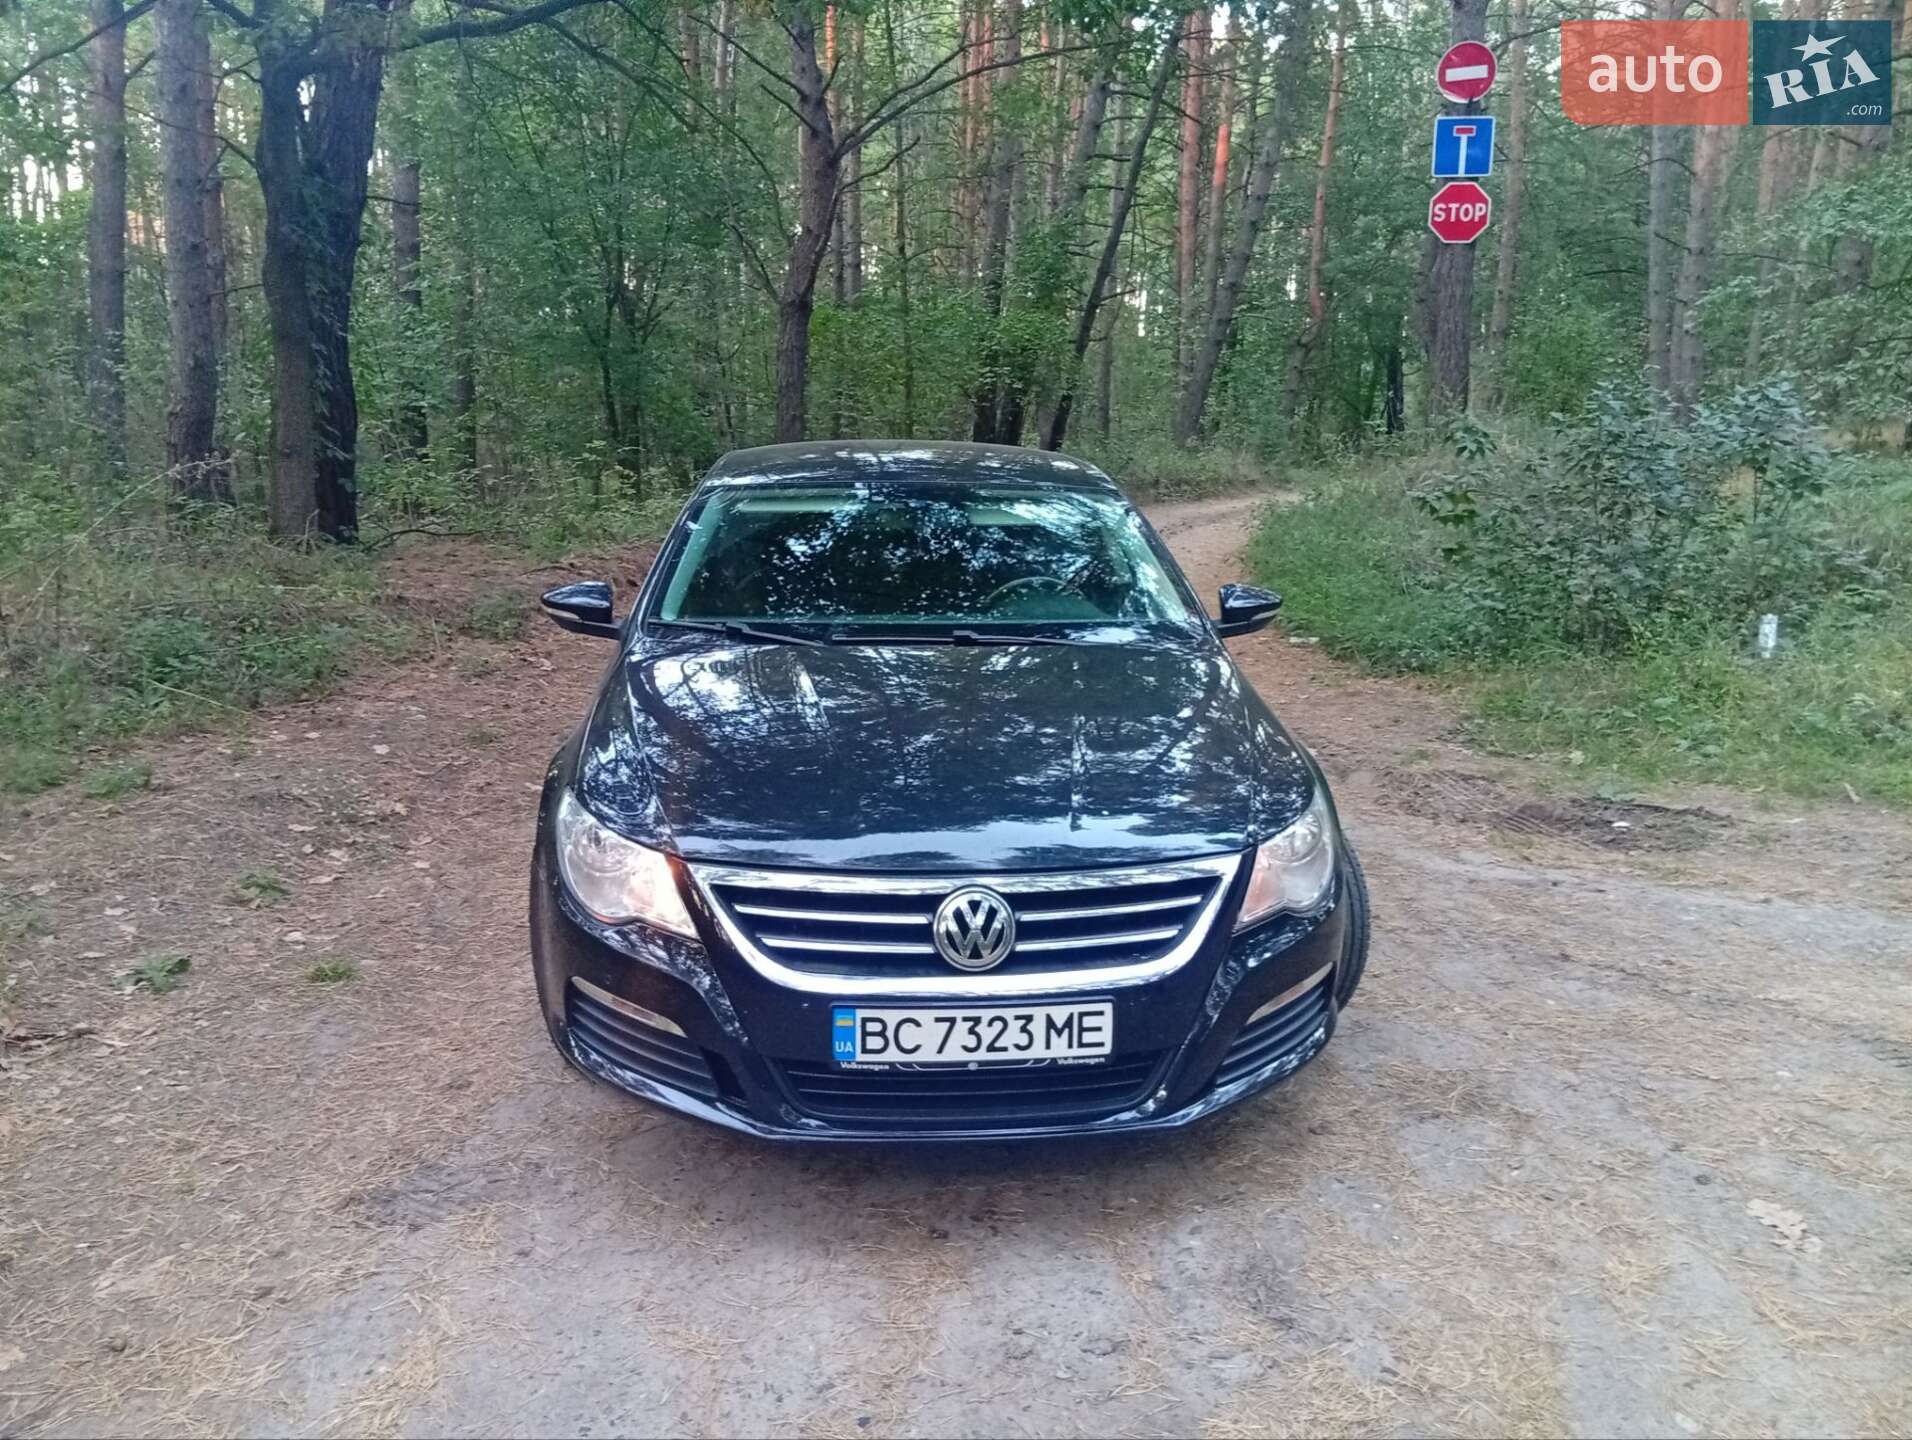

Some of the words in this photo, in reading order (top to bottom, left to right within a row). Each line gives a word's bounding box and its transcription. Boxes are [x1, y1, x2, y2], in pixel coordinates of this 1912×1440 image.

[1433, 203, 1487, 222] STOP
[860, 1016, 923, 1055] BC
[933, 1014, 1034, 1054] 7323
[1044, 1010, 1106, 1050] ME
[835, 1041, 854, 1053] UA
